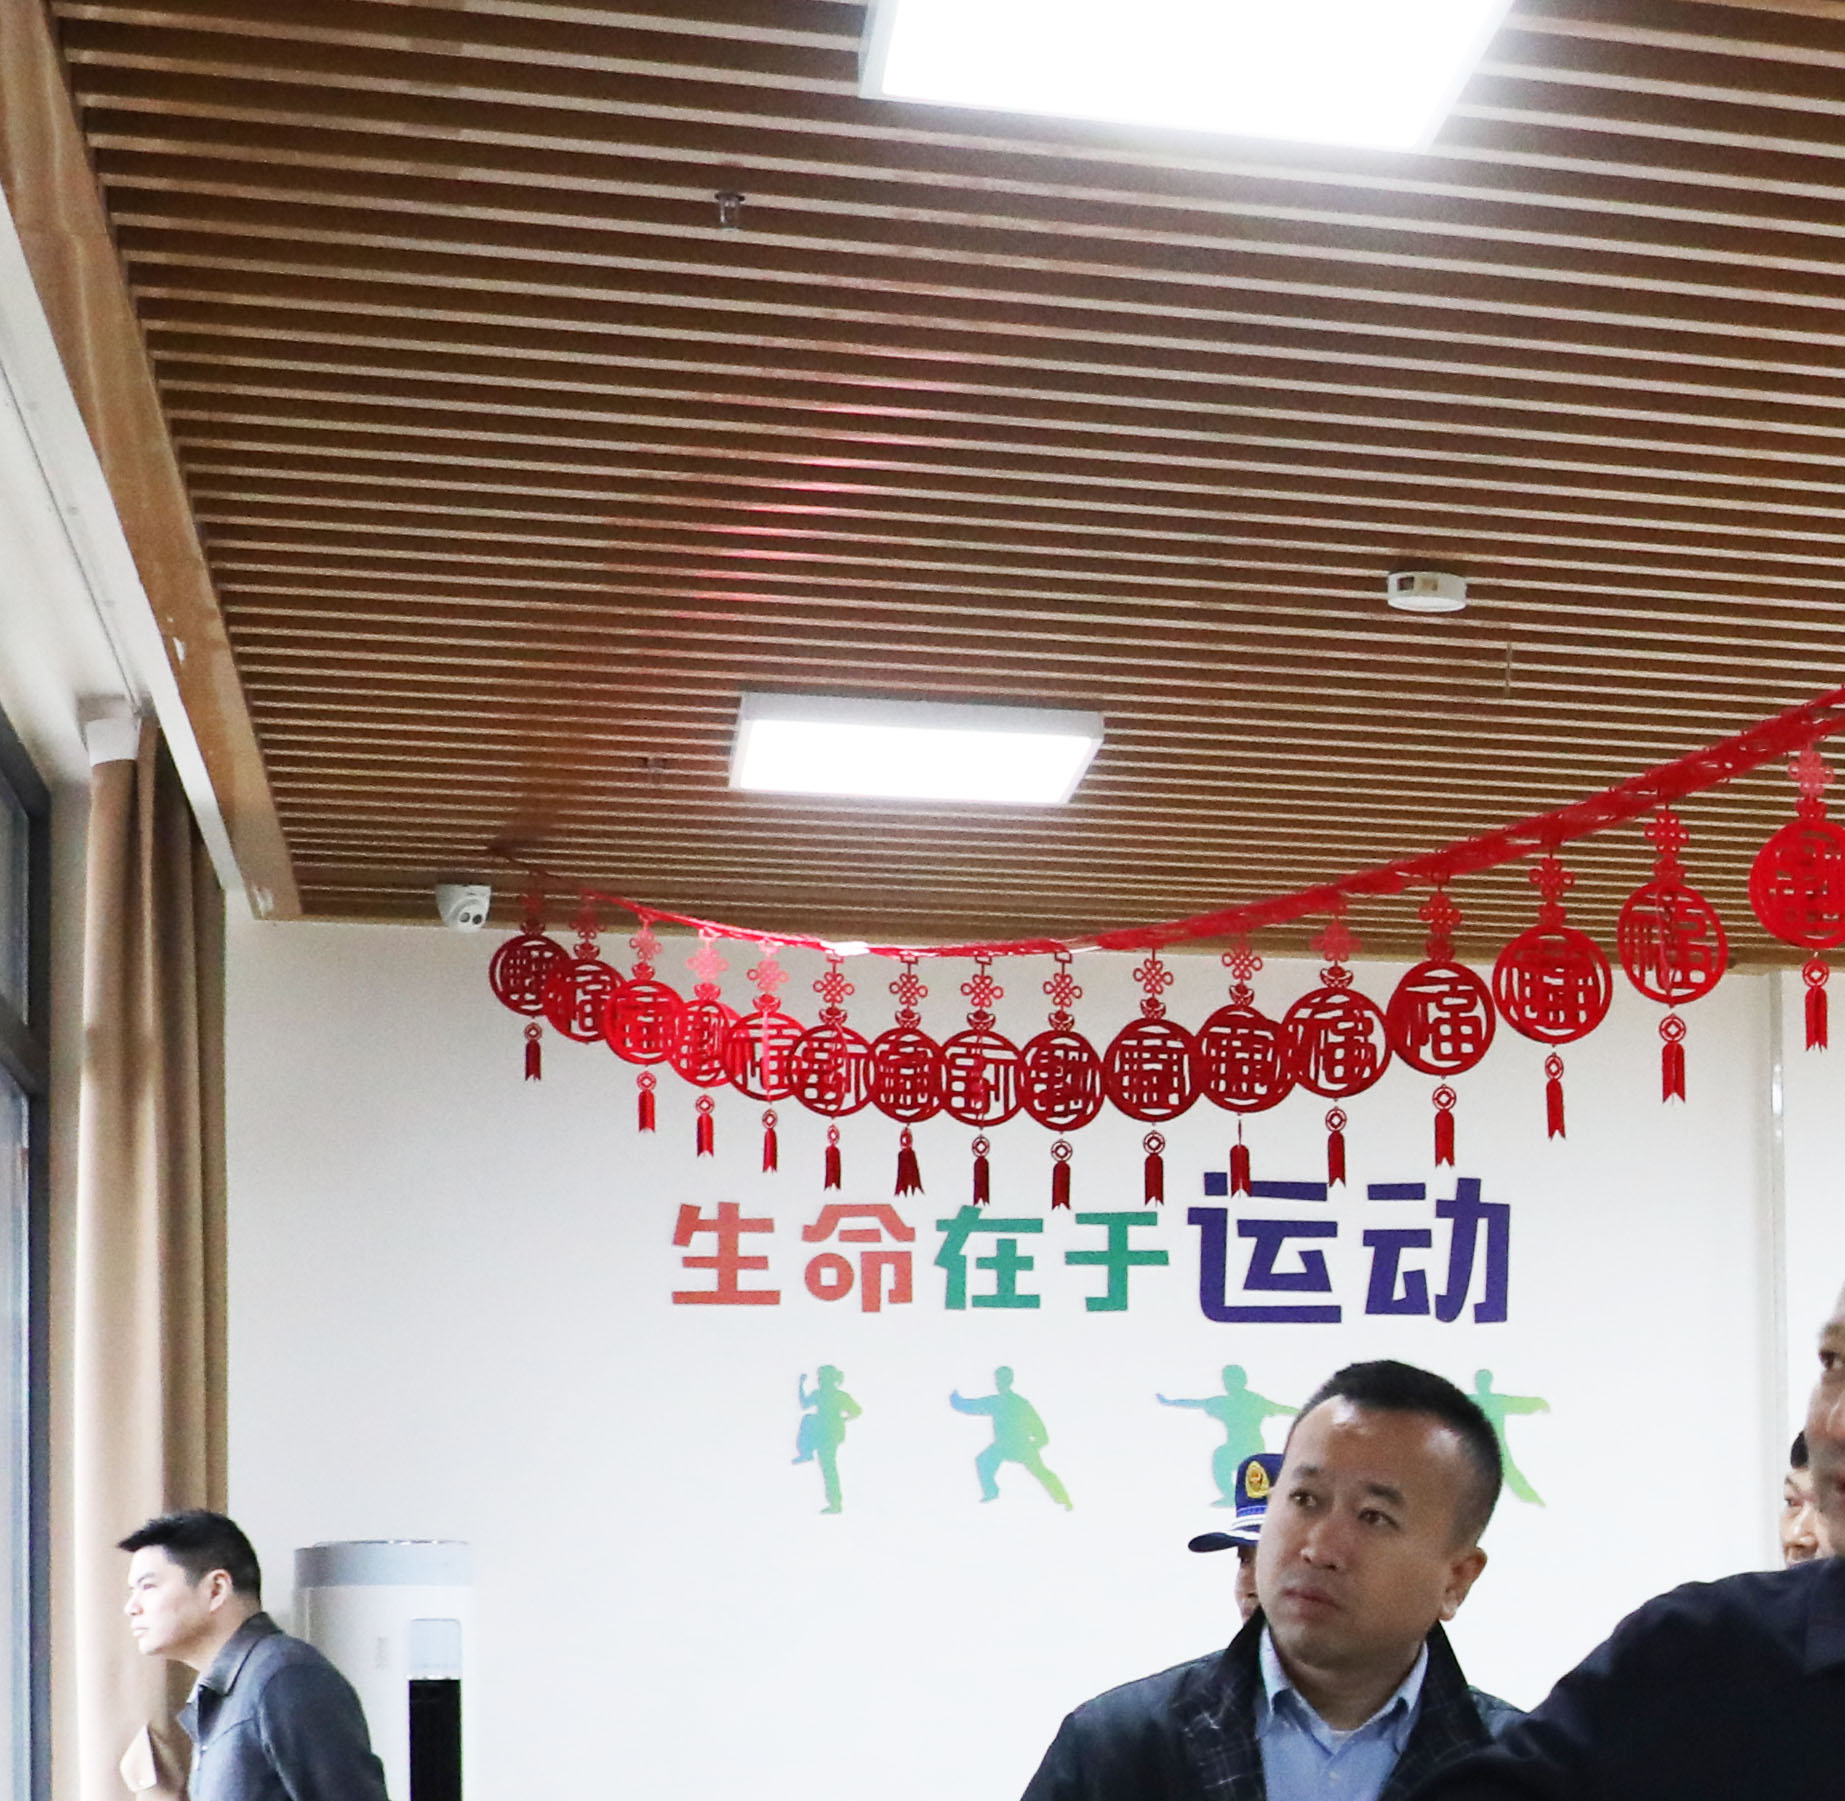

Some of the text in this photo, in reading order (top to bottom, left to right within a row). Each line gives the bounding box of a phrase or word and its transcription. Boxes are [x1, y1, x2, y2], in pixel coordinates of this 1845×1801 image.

[671, 1172, 1511, 1324] 生命在于运动
